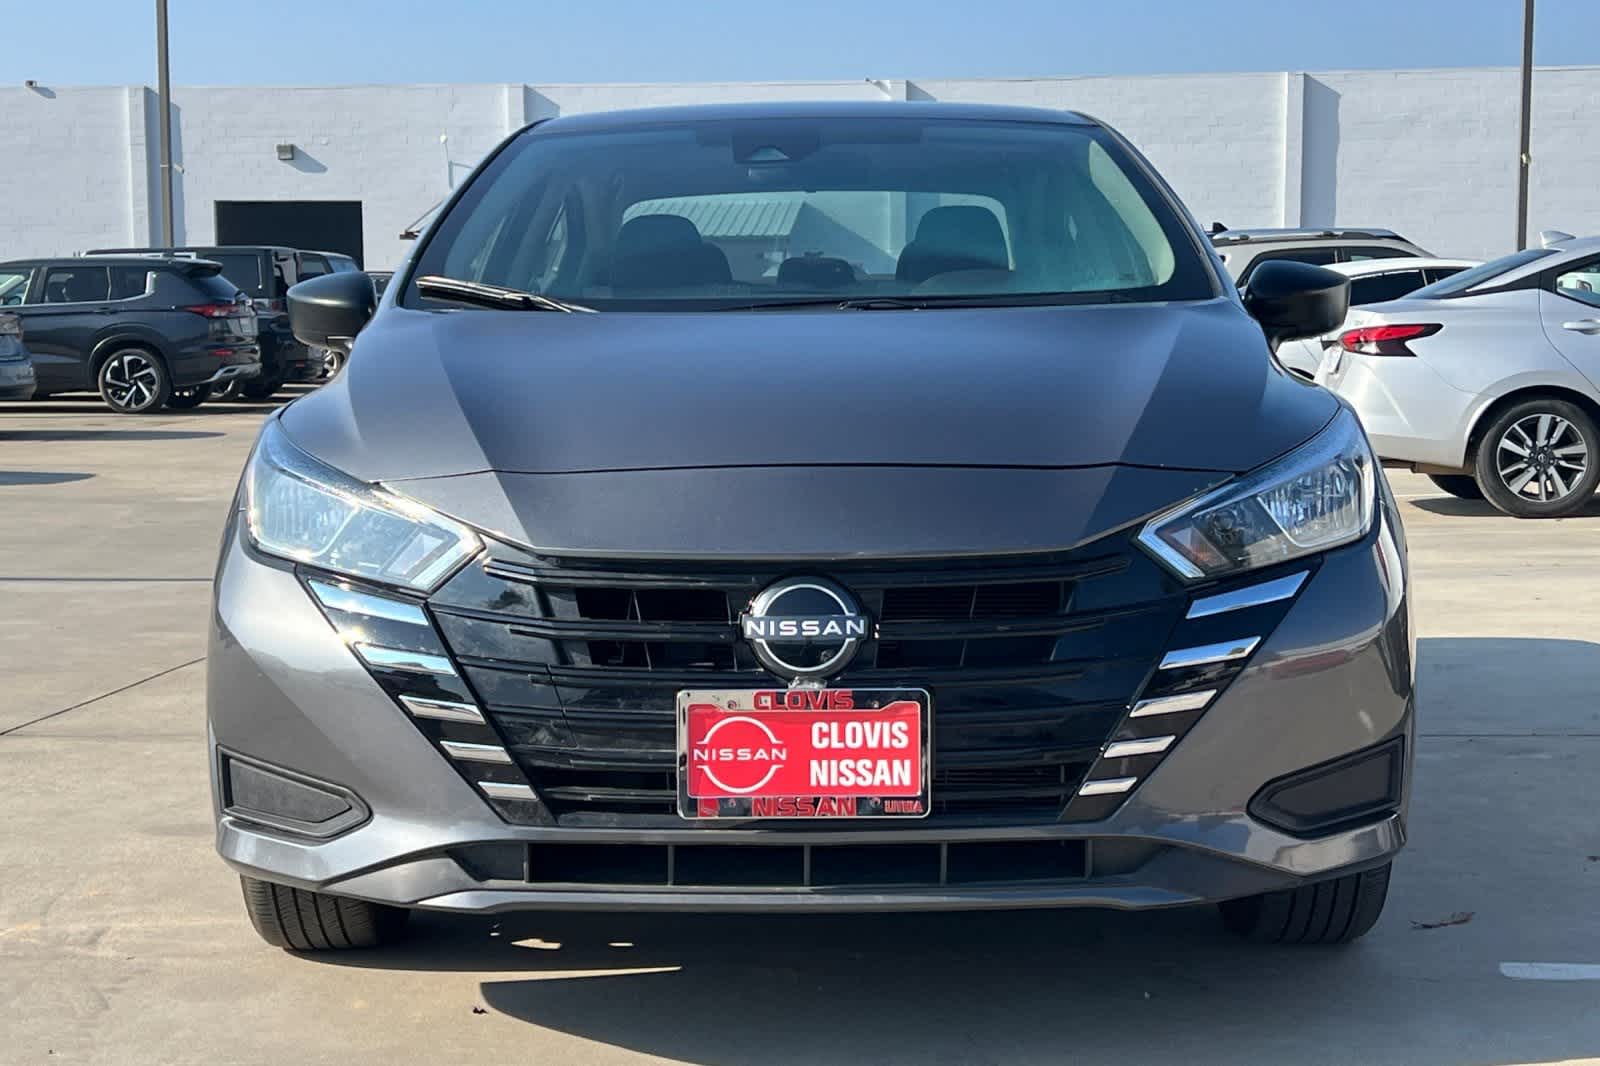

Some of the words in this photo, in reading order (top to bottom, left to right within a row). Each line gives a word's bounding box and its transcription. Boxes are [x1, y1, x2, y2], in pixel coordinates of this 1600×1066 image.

[747, 620, 865, 636] NISSAN
[753, 691, 854, 711] CLOVIS
[811, 721, 909, 749] CLOVIS
[693, 748, 787, 761] NISSAN
[810, 760, 911, 788] NISSAN
[752, 797, 857, 817] NISSAN
